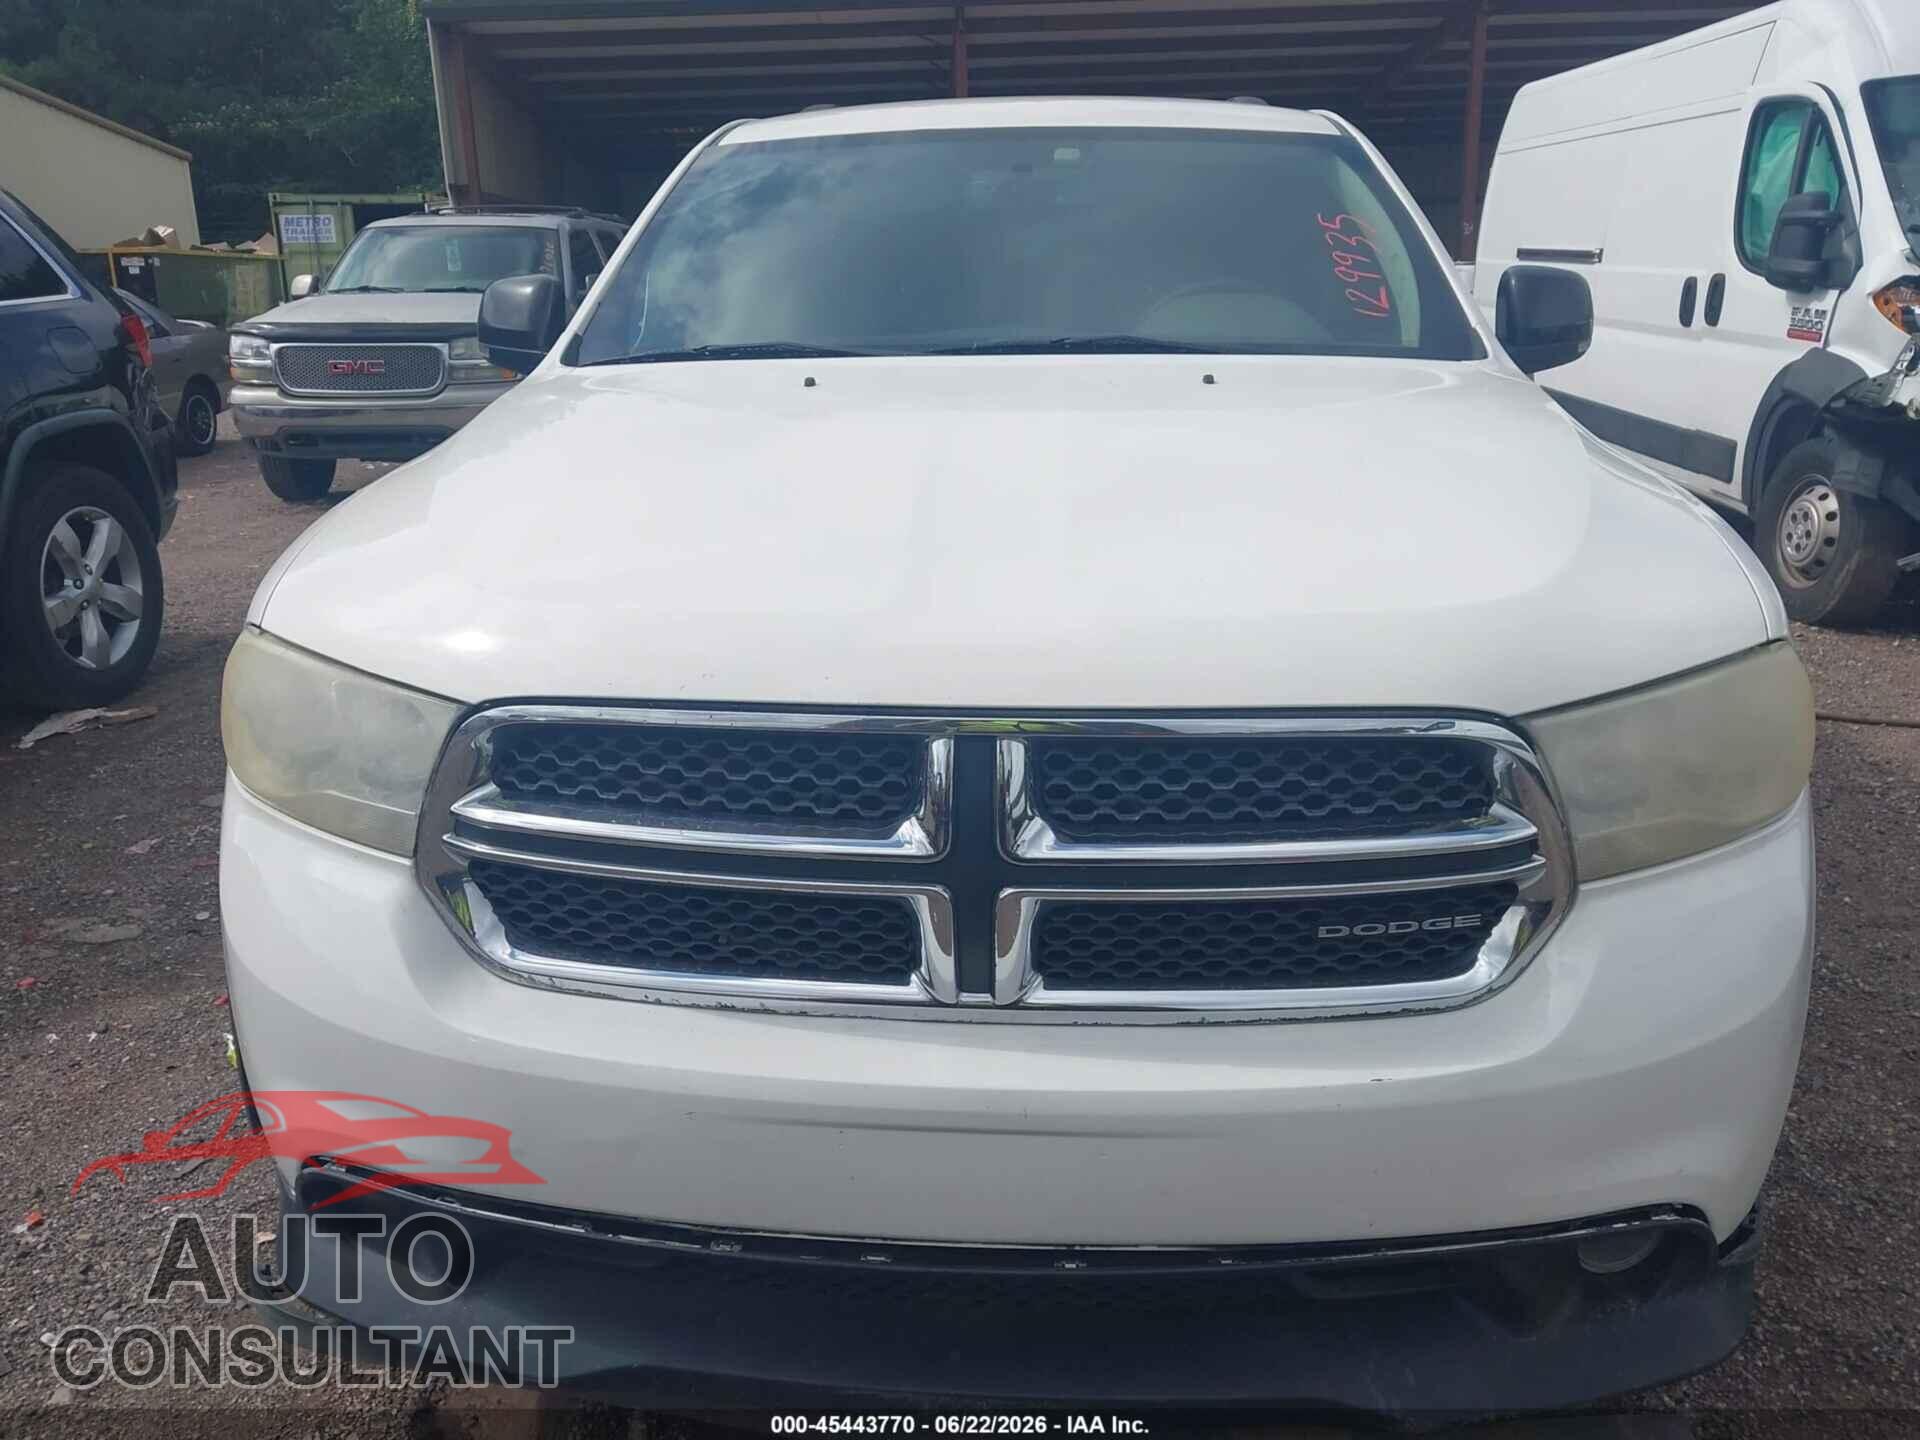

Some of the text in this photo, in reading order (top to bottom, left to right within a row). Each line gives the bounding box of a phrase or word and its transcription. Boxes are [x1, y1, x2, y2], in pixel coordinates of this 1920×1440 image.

[284, 216, 331, 227] METRO
[1317, 213, 1390, 317] 129935
[327, 360, 385, 375] GMC
[1317, 913, 1482, 938] DODGE
